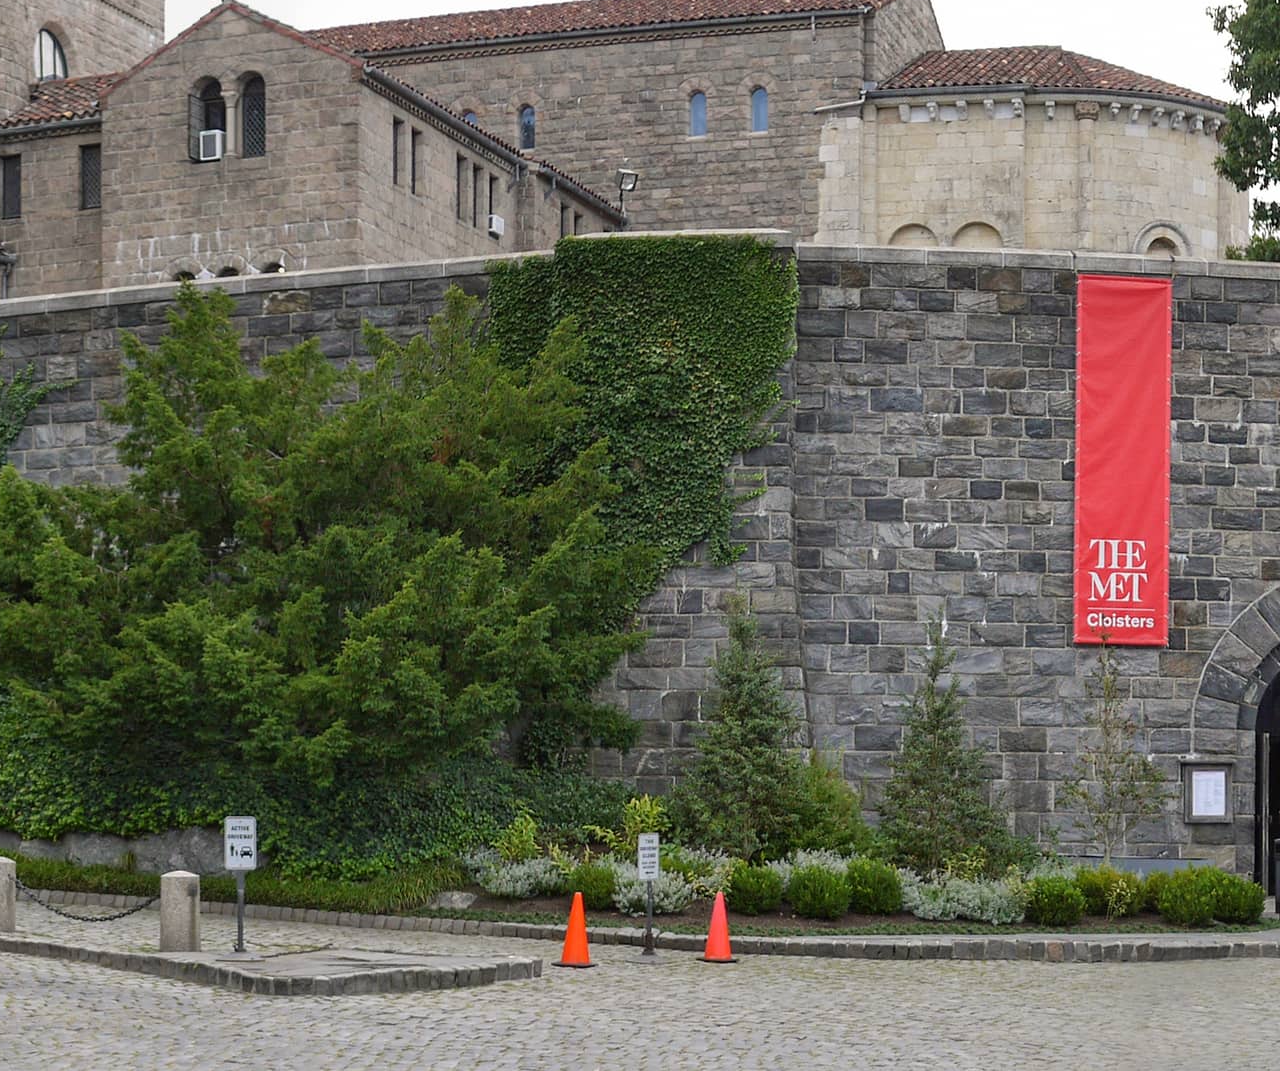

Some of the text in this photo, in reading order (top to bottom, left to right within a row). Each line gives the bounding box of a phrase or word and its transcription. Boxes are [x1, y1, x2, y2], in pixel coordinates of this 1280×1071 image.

[1089, 539, 1147, 570] THE
[1087, 571, 1148, 602] MET
[1087, 612, 1154, 628] Cloisters
